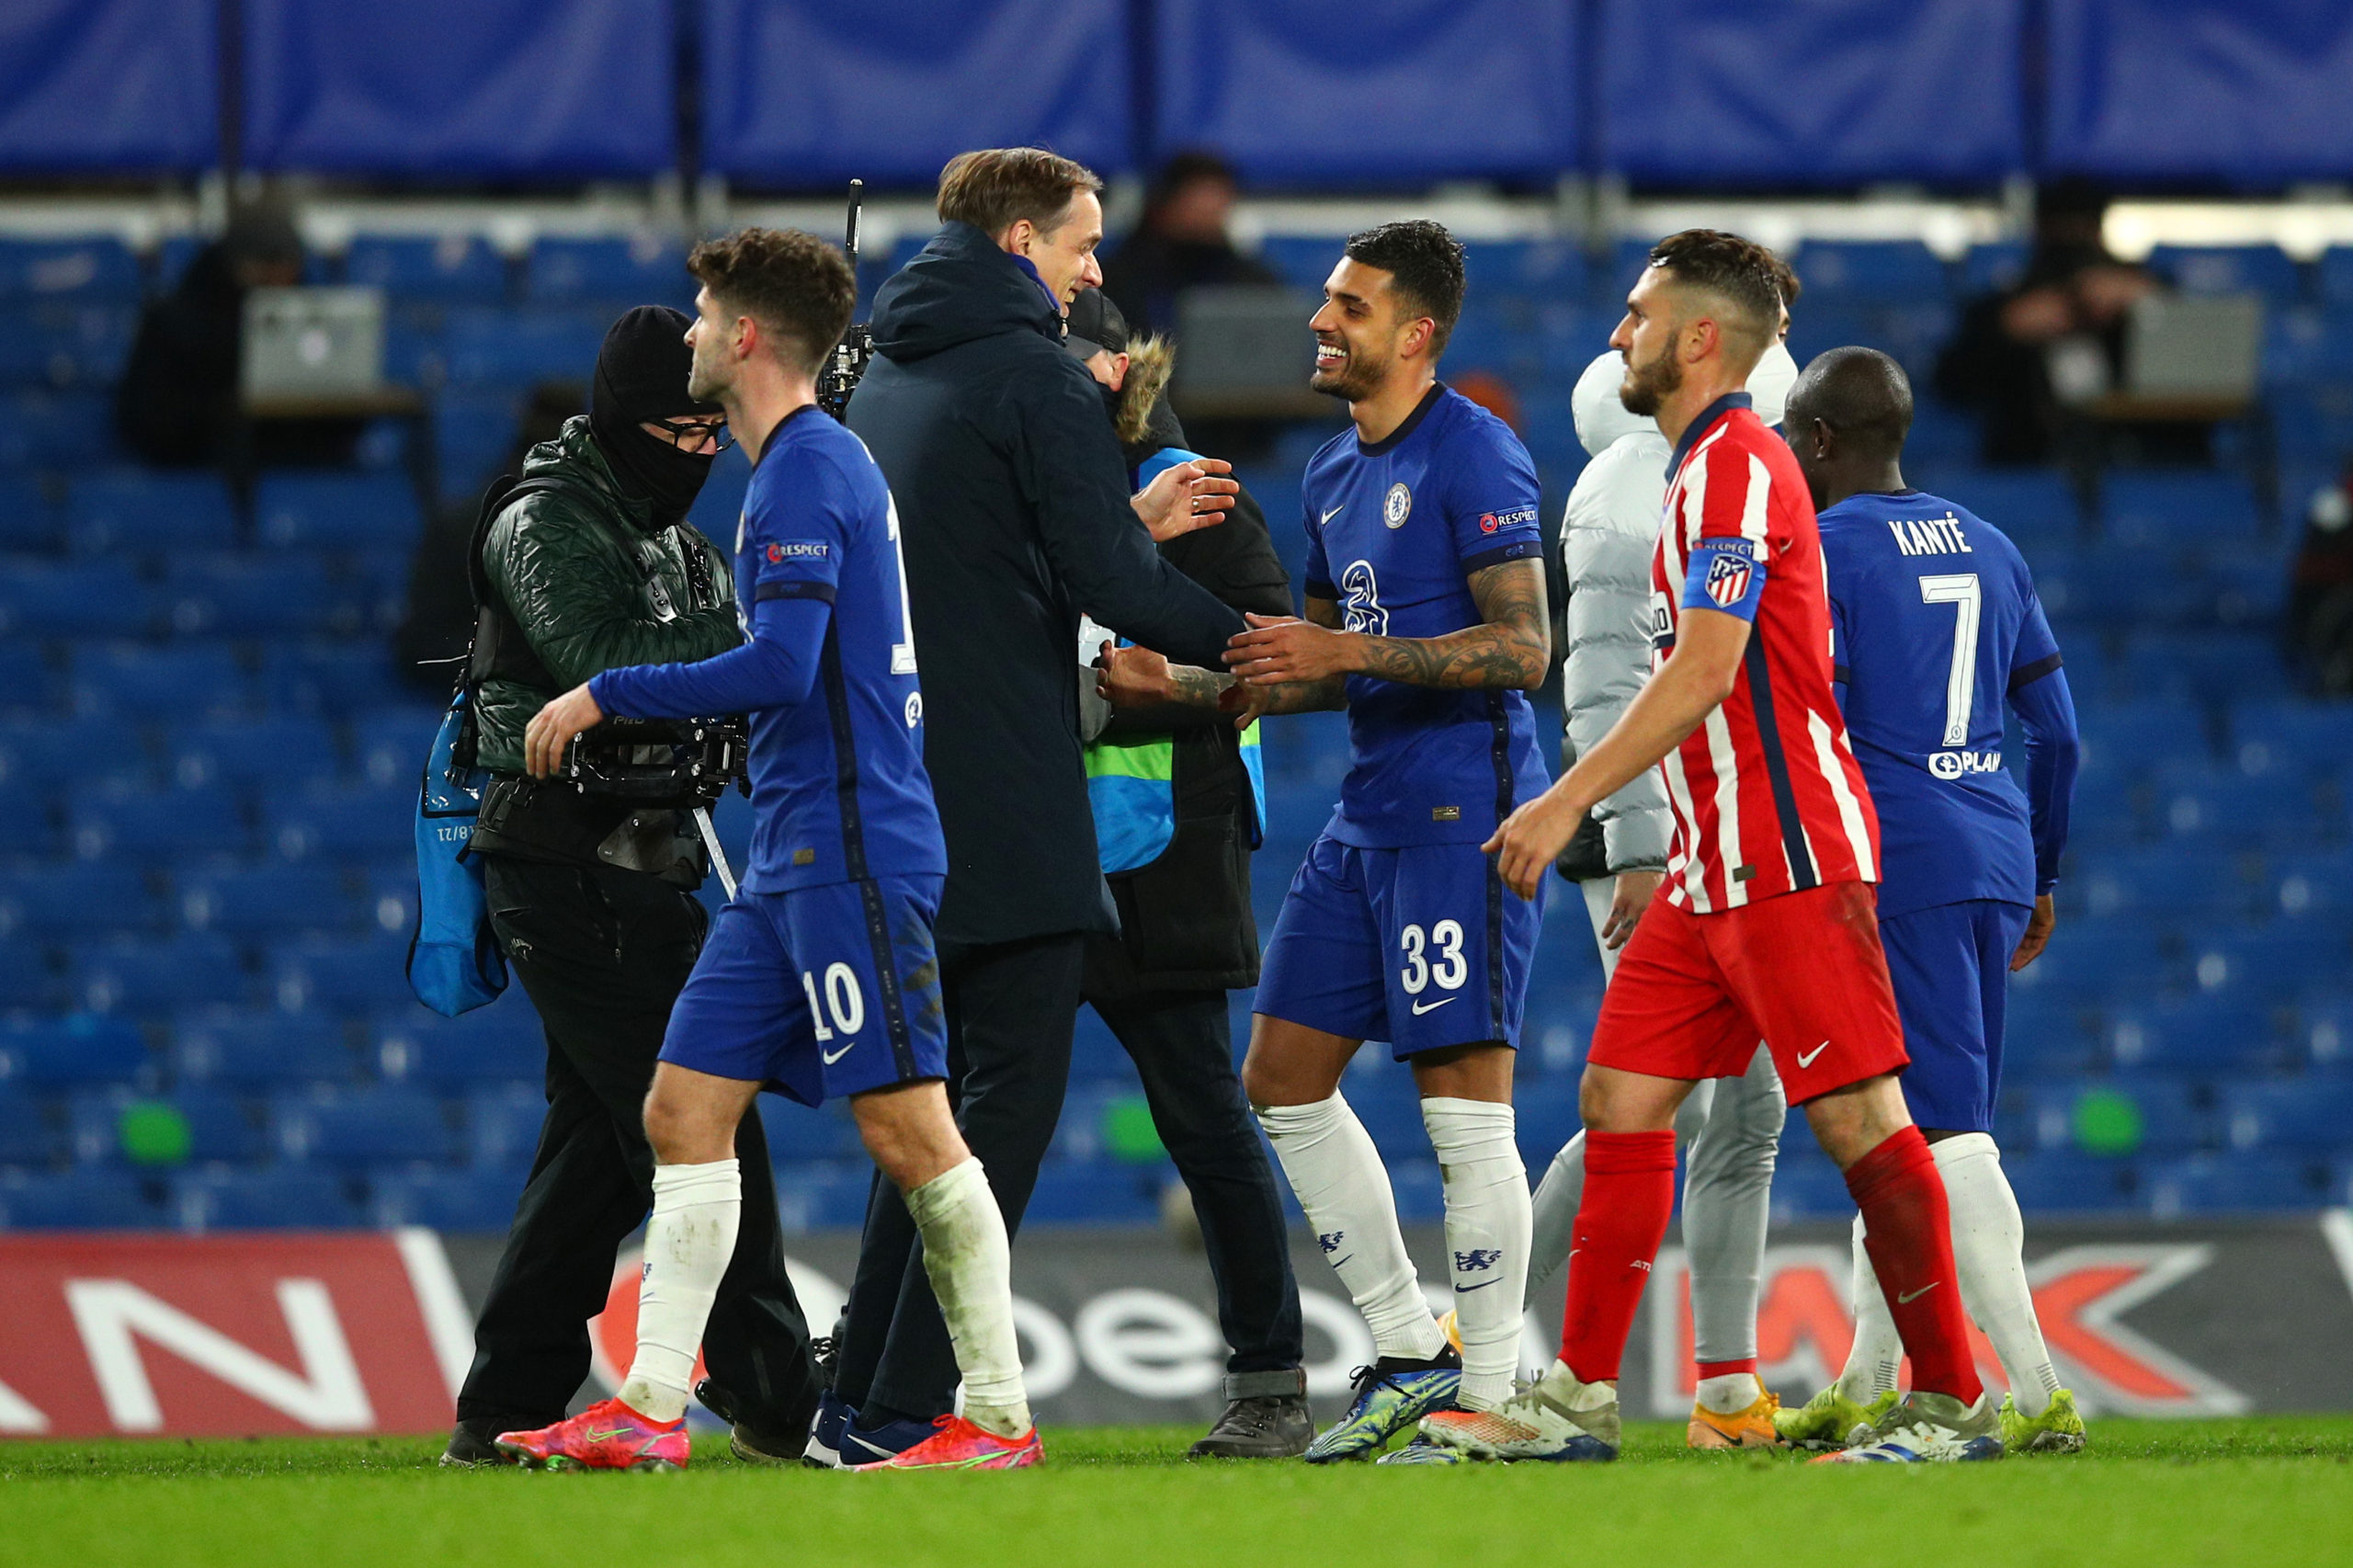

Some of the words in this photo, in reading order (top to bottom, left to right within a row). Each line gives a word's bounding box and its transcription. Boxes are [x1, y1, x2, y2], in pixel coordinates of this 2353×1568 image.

[780, 544, 829, 557] RESPECT
[1497, 510, 1536, 527] RESPECT
[1888, 511, 1973, 556] KANTÉ
[1918, 573, 1982, 746] 7
[1961, 751, 2001, 773] PLAN
[1401, 919, 1469, 994] 33
[802, 961, 865, 1041] 10
[0, 1278, 375, 1431] N
[1651, 1244, 2254, 1419] MX
